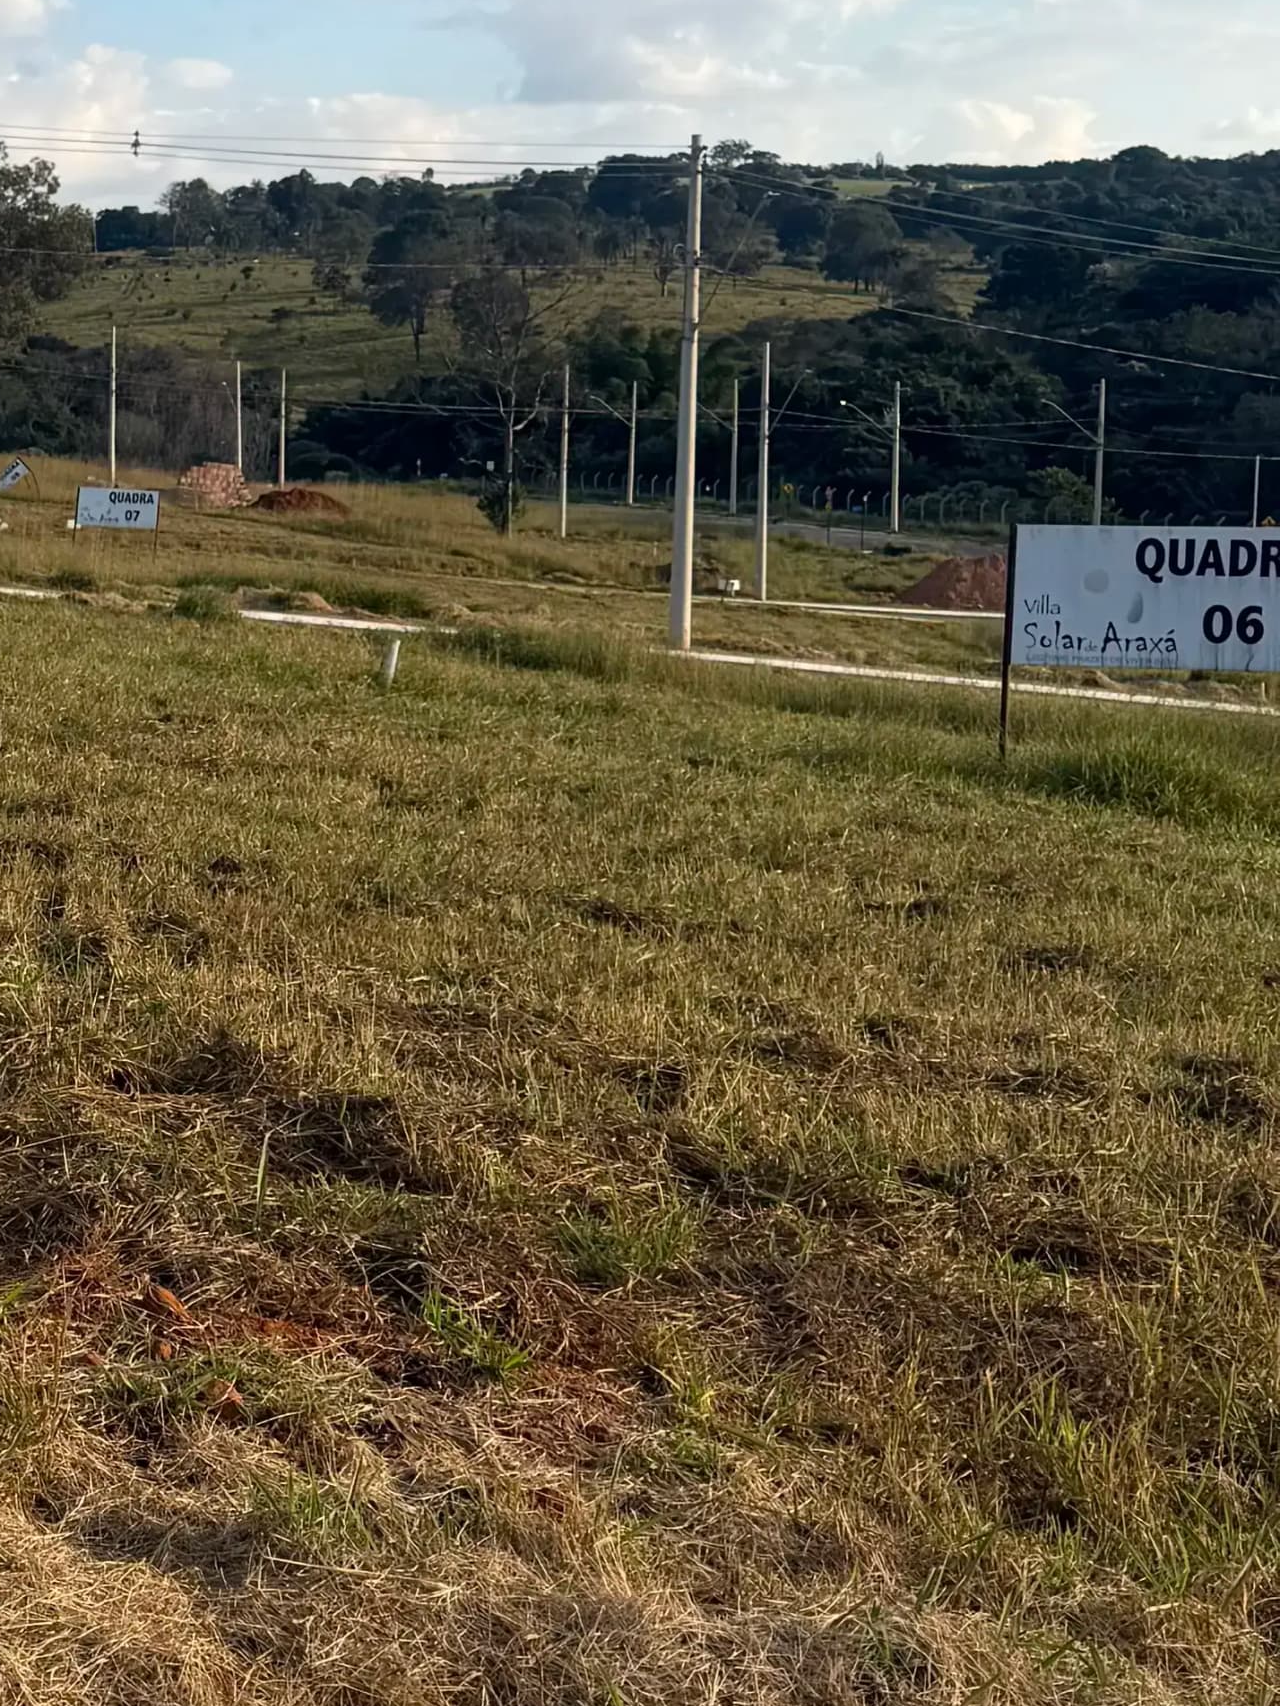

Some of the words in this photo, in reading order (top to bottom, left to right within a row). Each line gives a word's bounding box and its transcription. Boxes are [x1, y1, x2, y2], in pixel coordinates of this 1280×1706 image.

[108, 491, 154, 505] QUADRA
[124, 510, 140, 522] 07
[1023, 593, 1061, 615] Villa
[1202, 604, 1265, 644] 06
[1023, 620, 1088, 651] Solar
[1100, 620, 1178, 654] Araxá
